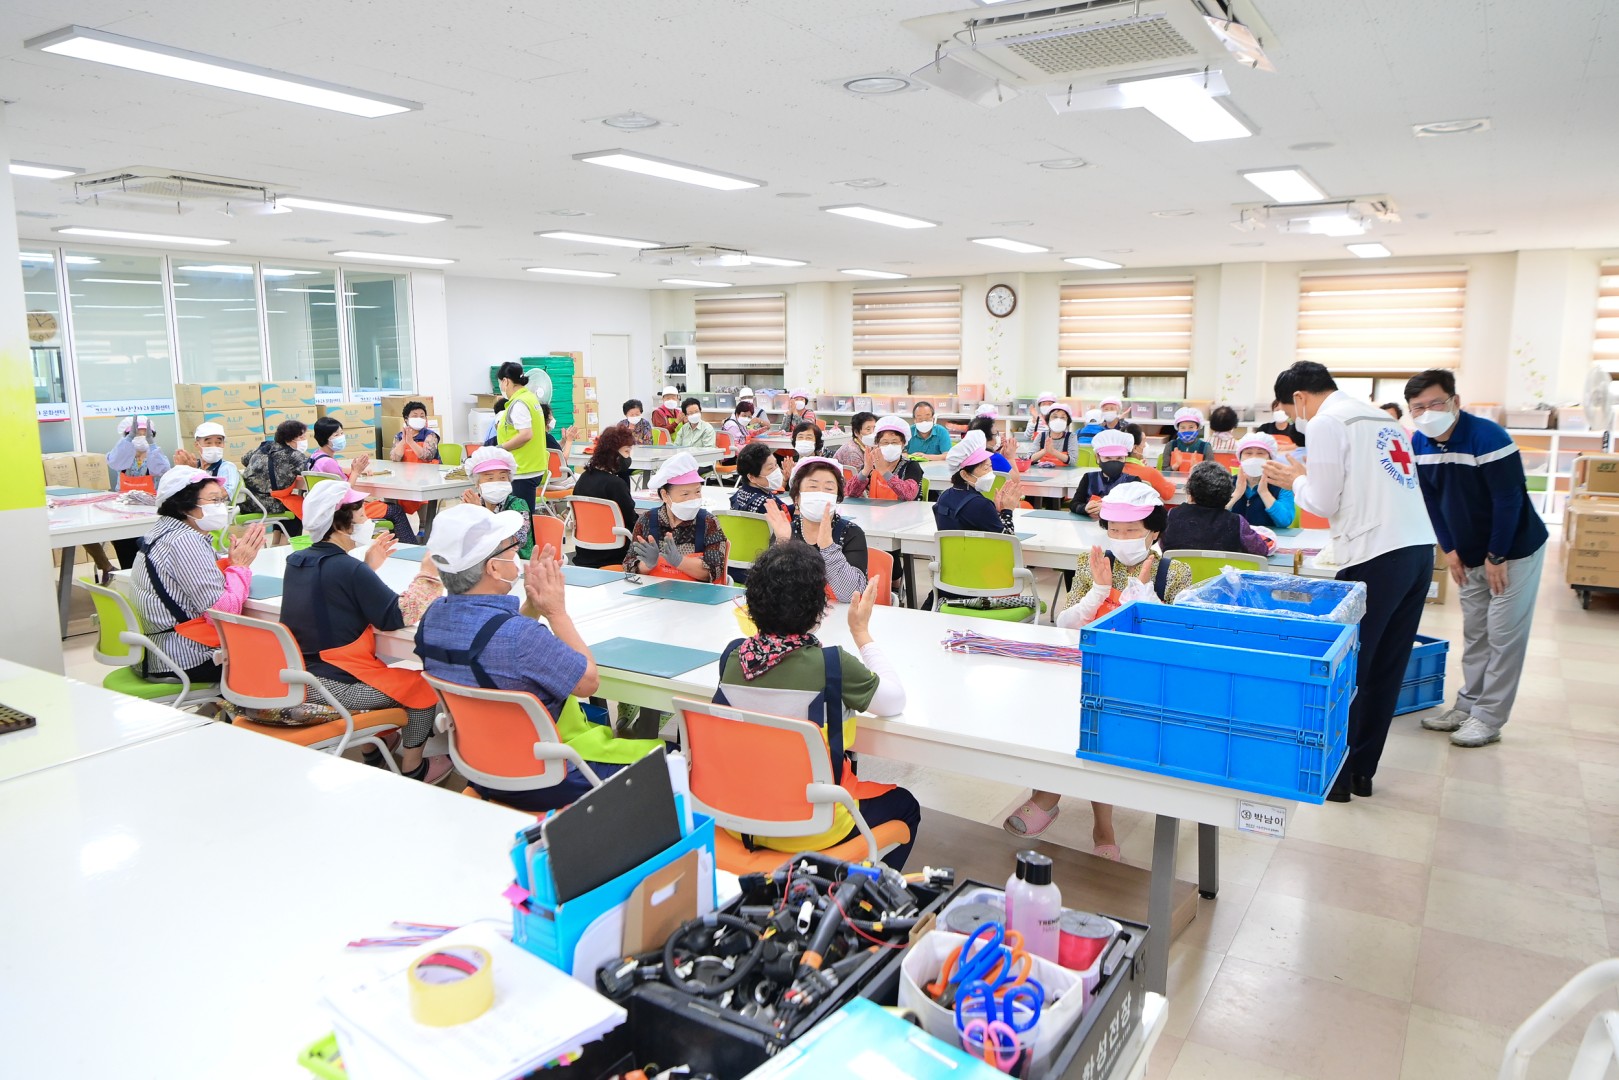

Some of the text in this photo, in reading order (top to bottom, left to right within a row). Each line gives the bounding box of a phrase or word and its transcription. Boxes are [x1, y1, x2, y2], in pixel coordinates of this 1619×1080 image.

[42, 409, 66, 417] 문화센터
[1380, 457, 1405, 486] KOREAN
[1254, 812, 1284, 827] 박남이
